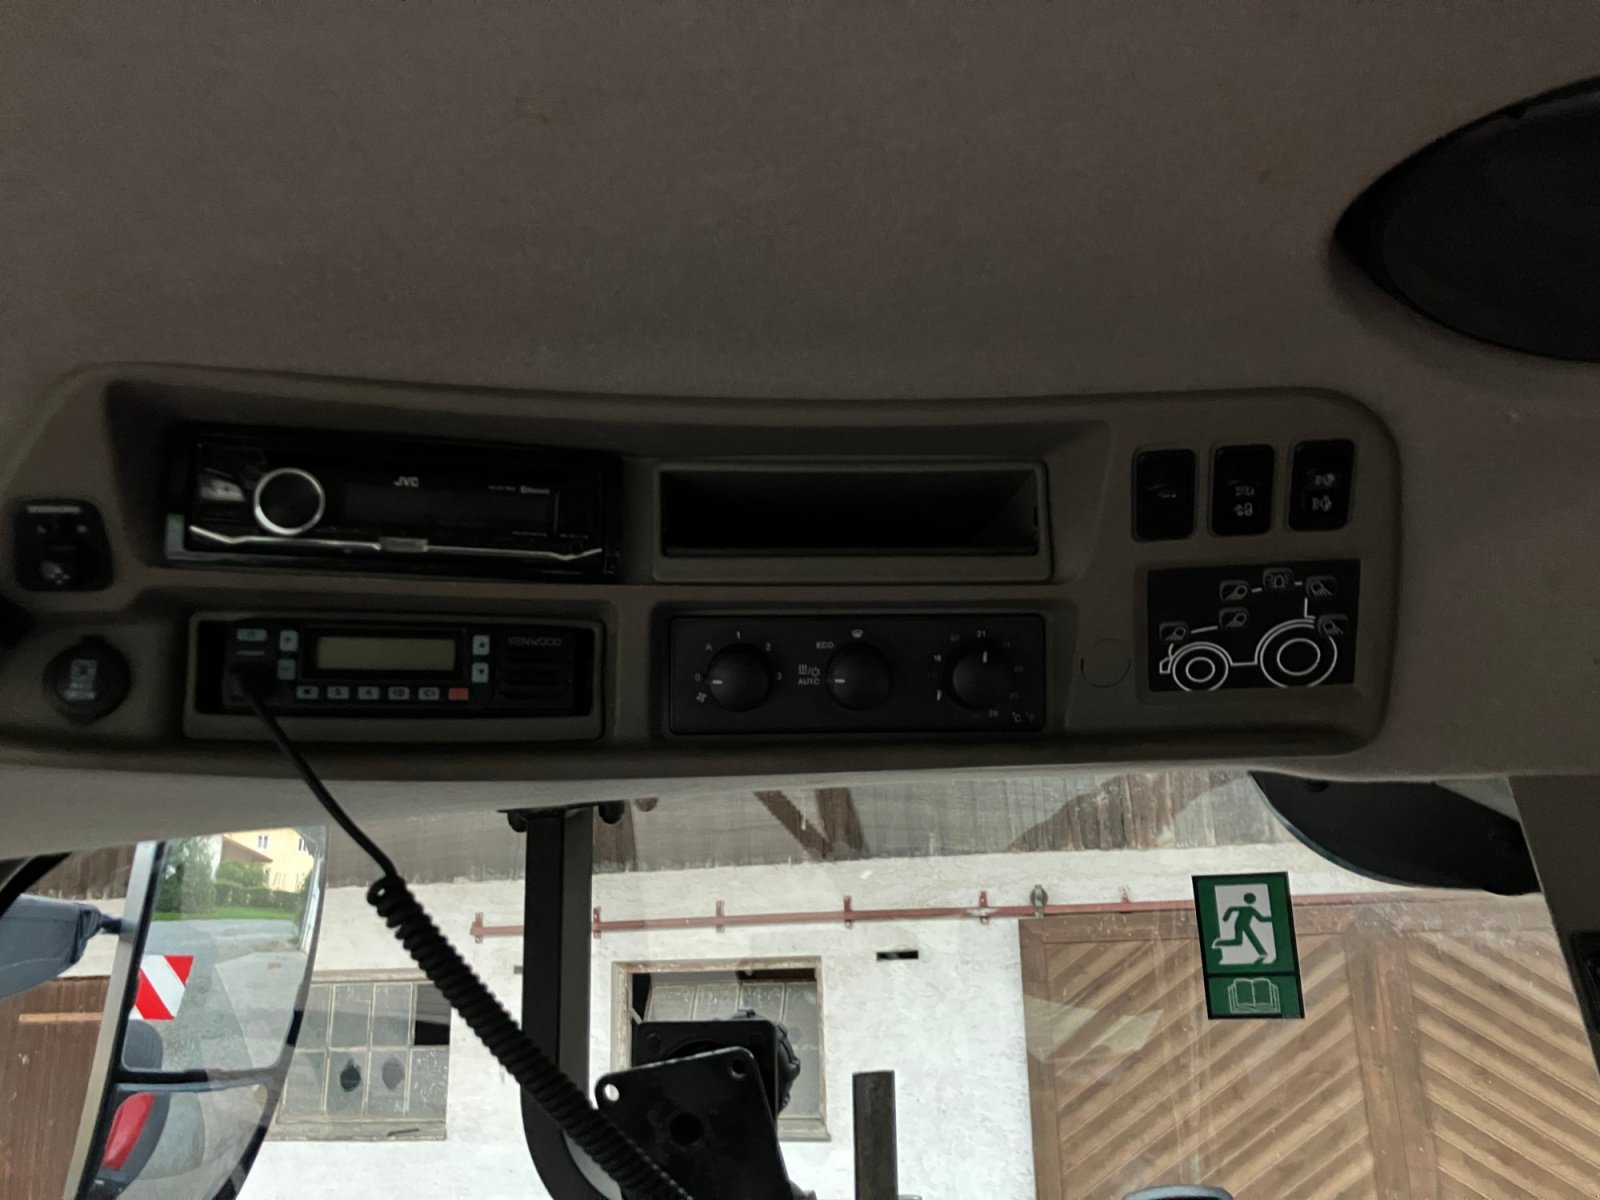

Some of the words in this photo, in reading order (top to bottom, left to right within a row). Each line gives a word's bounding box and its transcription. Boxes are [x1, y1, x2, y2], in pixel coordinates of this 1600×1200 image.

[394, 476, 420, 488] JVC
[736, 631, 741, 640] 1
[507, 637, 561, 647] KENWOOD
[816, 641, 834, 650] ECO
[705, 643, 713, 651] A
[798, 677, 821, 686] AUTO
